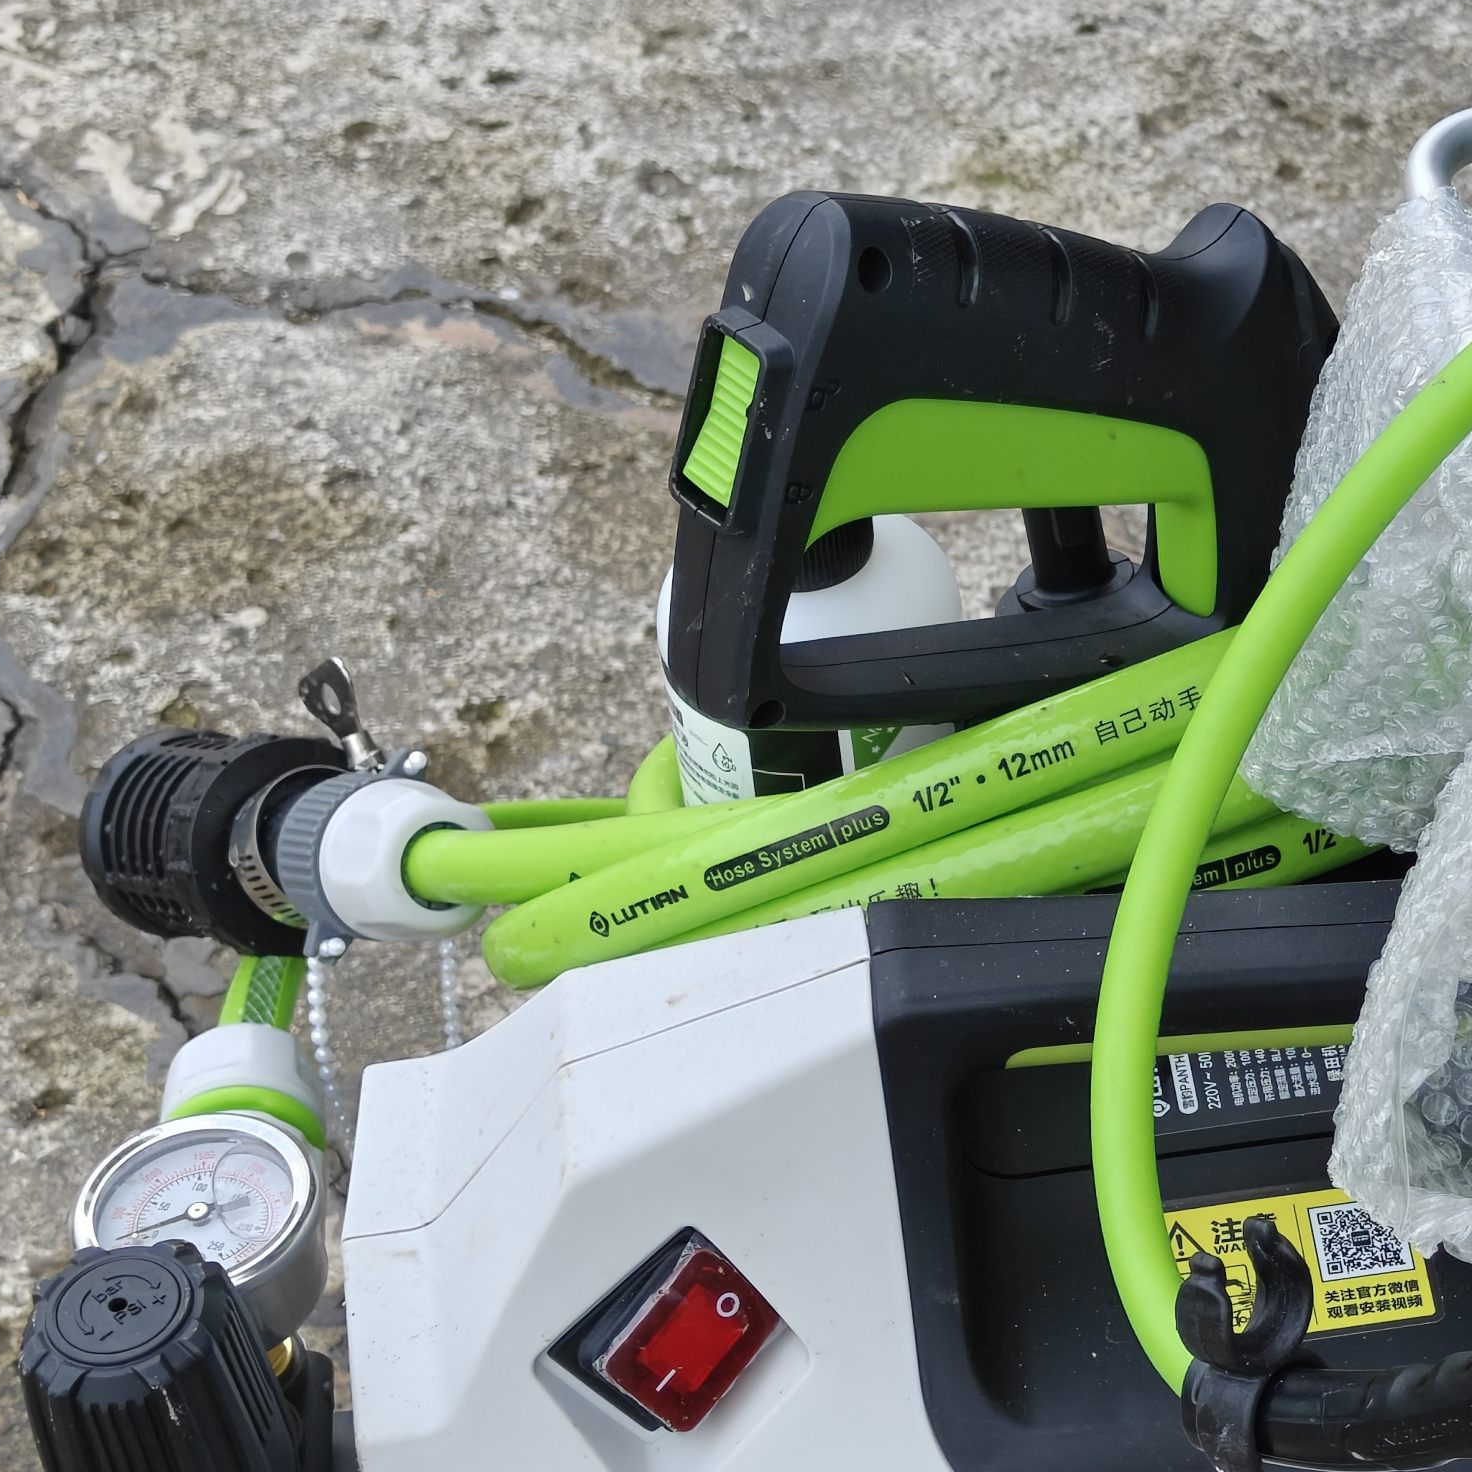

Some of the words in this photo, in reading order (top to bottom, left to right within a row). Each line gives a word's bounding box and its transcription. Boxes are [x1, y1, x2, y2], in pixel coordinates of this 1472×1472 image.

[611, 884, 689, 925] LUTIAN
[711, 860, 756, 888] Hose
[760, 831, 828, 869] System
[839, 811, 886, 841] plus
[997, 740, 1076, 781] 12mm
[1094, 685, 1202, 746] 自己动手
[1234, 851, 1276, 877] plus
[92, 1280, 124, 1305] bar
[1324, 1279, 1420, 1304] 关注官方微信
[1326, 1294, 1424, 1319] 观看安装视频
